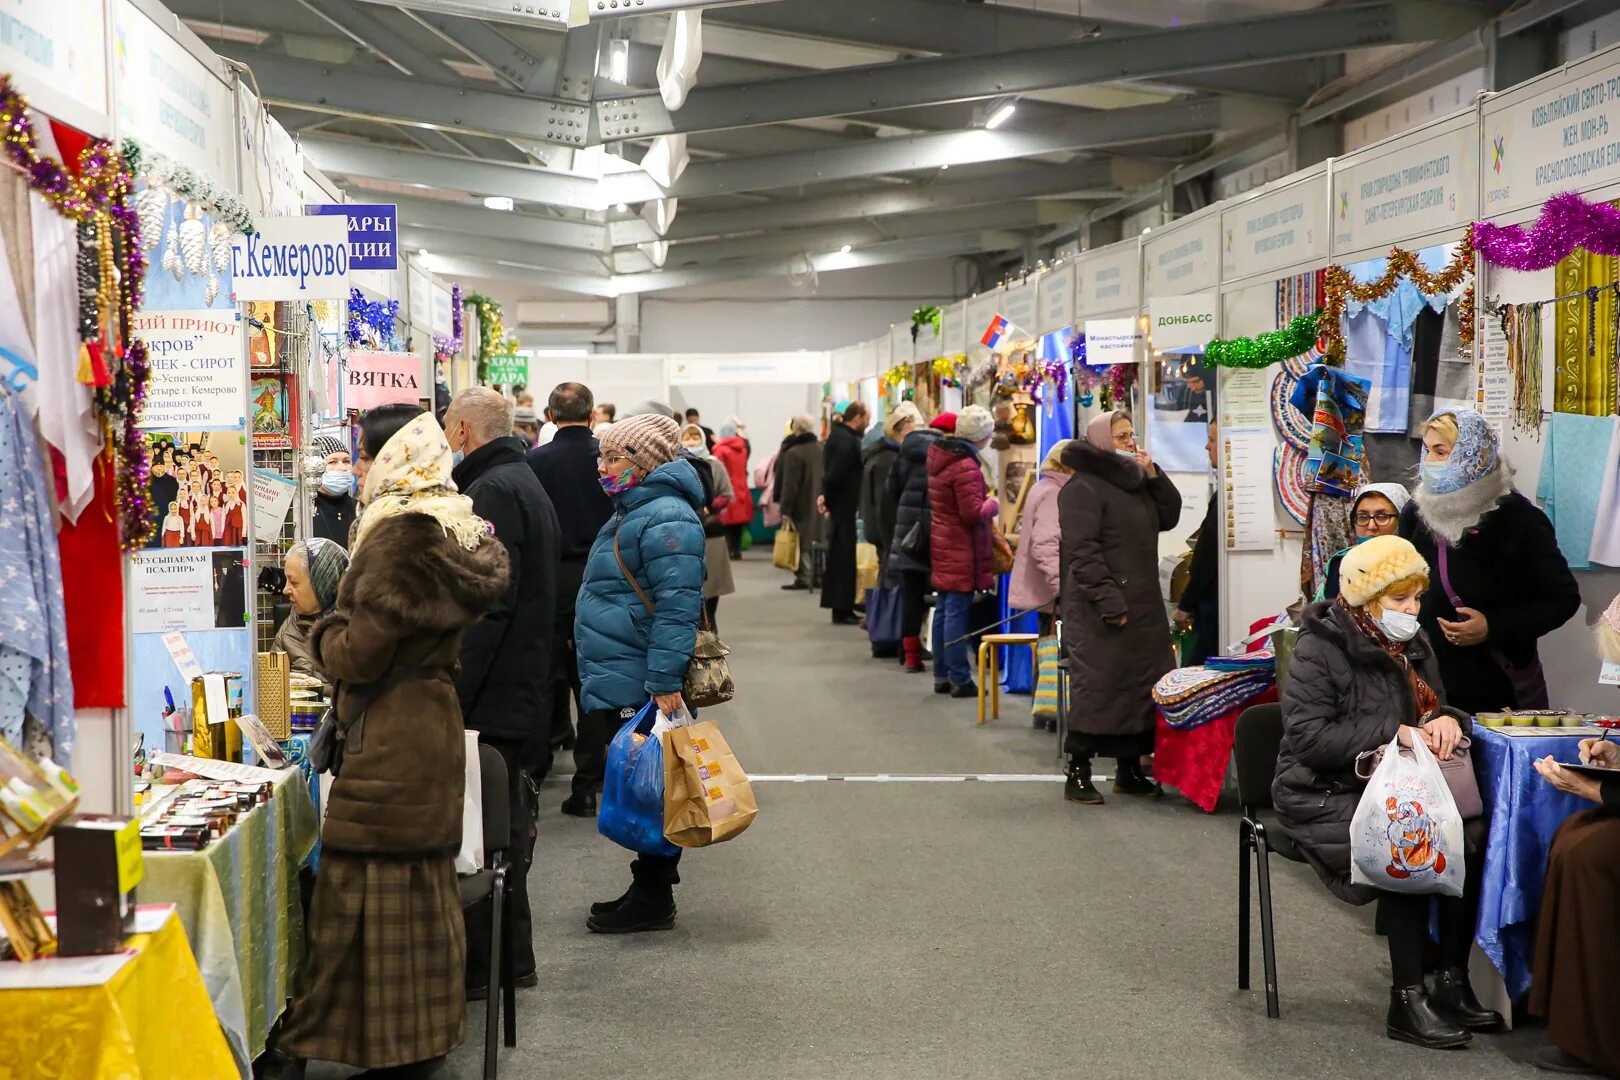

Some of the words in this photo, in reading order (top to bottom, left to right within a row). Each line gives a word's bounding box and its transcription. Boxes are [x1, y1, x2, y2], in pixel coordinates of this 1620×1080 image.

[1531, 88, 1580, 129] КОВЫЛЯЙСКИЙ
[1581, 114, 1608, 142] МОН-РЬ
[1536, 147, 1604, 187] КРАСНОСЛОБОДСКАЯ
[232, 231, 347, 289] г.Кемерово
[172, 318, 239, 336] ПРИЮТ
[1158, 314, 1213, 327] ДОНБАСС
[149, 359, 179, 370] ЧЕК
[190, 357, 235, 370] СИРОТ
[491, 357, 525, 367] ХРАМ
[150, 374, 213, 384] о-Успенском
[350, 370, 418, 389] ВЯТКА
[149, 387, 180, 398] стыре
[191, 385, 237, 397] Кемерово
[139, 413, 211, 423] очки-сироты
[146, 565, 195, 574] ПСАЛТИРЬ
